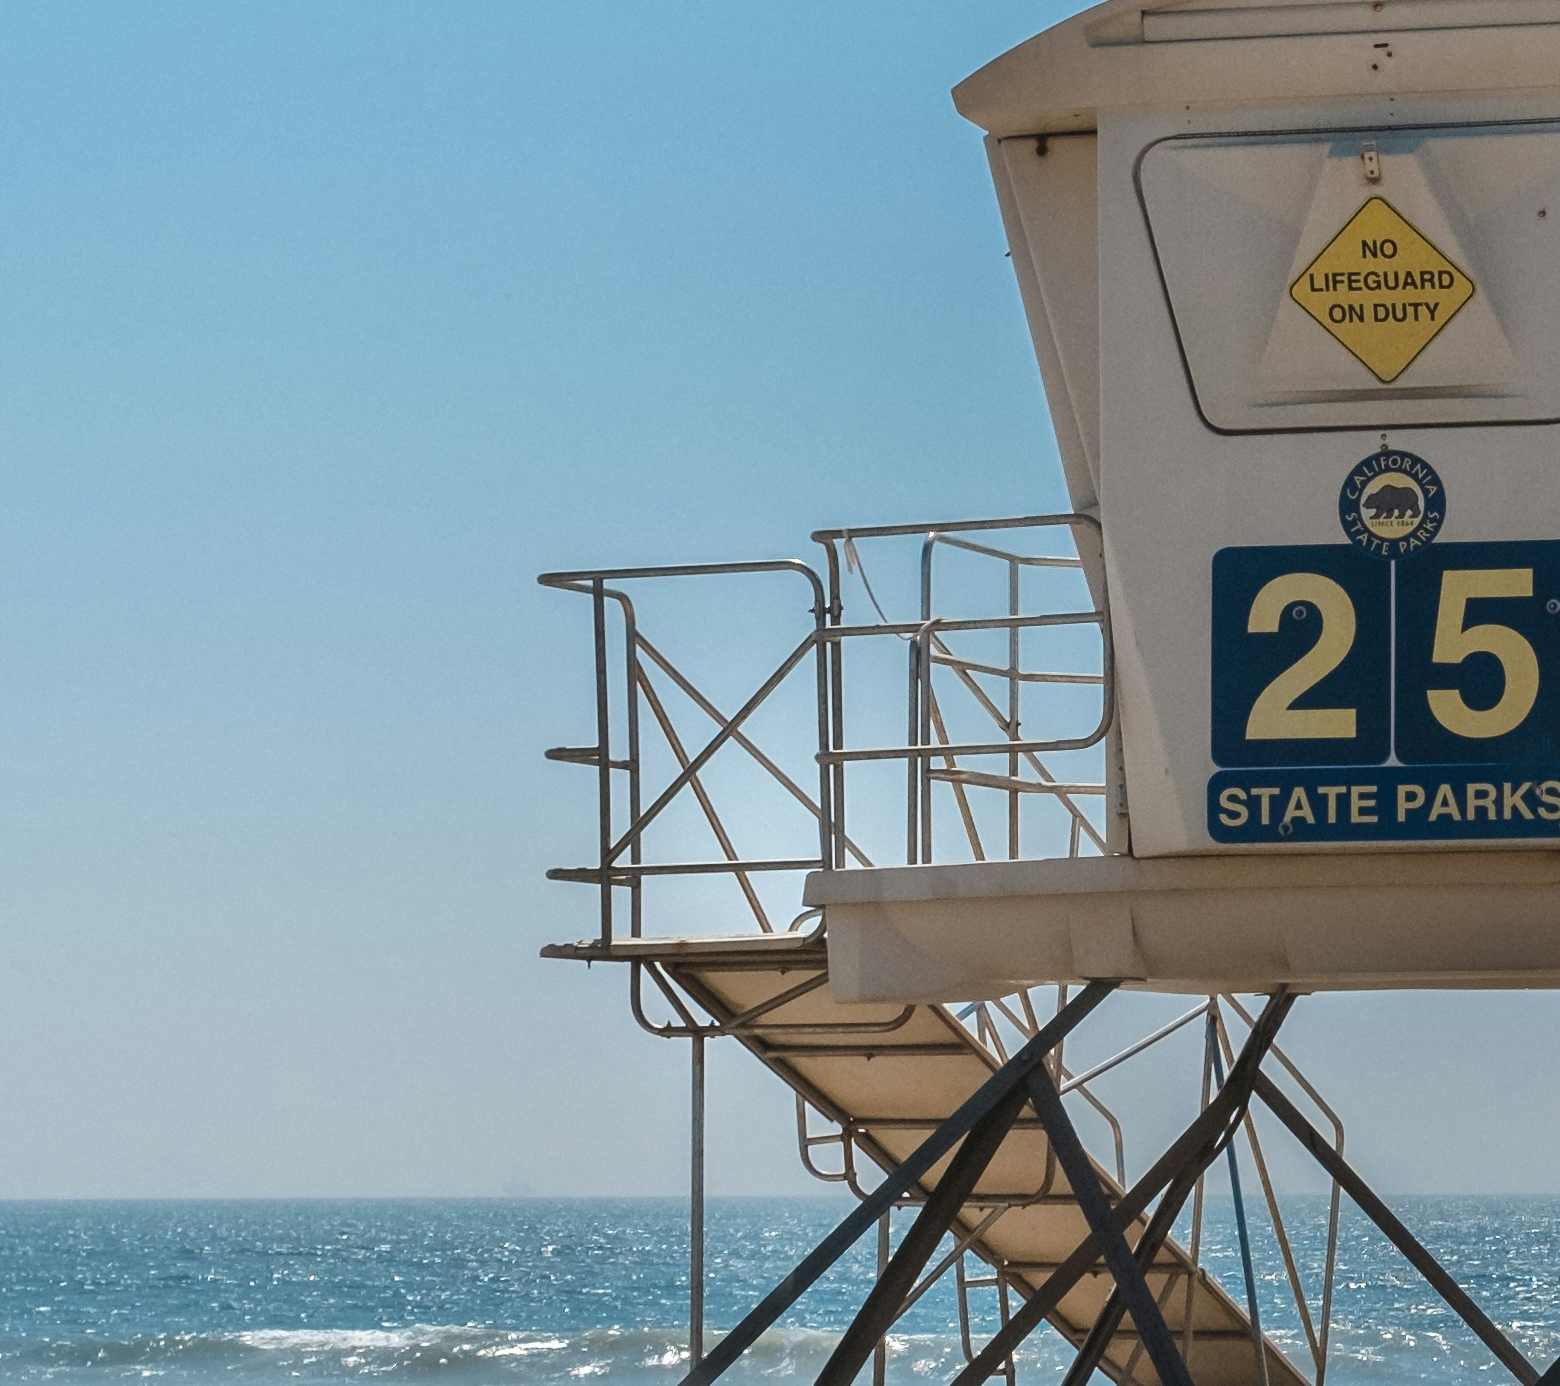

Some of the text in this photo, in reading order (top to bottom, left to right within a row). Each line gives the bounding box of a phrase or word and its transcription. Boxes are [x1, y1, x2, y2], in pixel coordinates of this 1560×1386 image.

[1361, 238, 1398, 260] NO
[1308, 269, 1455, 293] LIFEGUARD
[1328, 301, 1440, 324] ON DUTY
[1346, 455, 1439, 500] CALIFORNIA
[1345, 510, 1440, 556] STATE PARKS
[1245, 568, 1540, 740] 25
[1218, 784, 1379, 827] STATE
